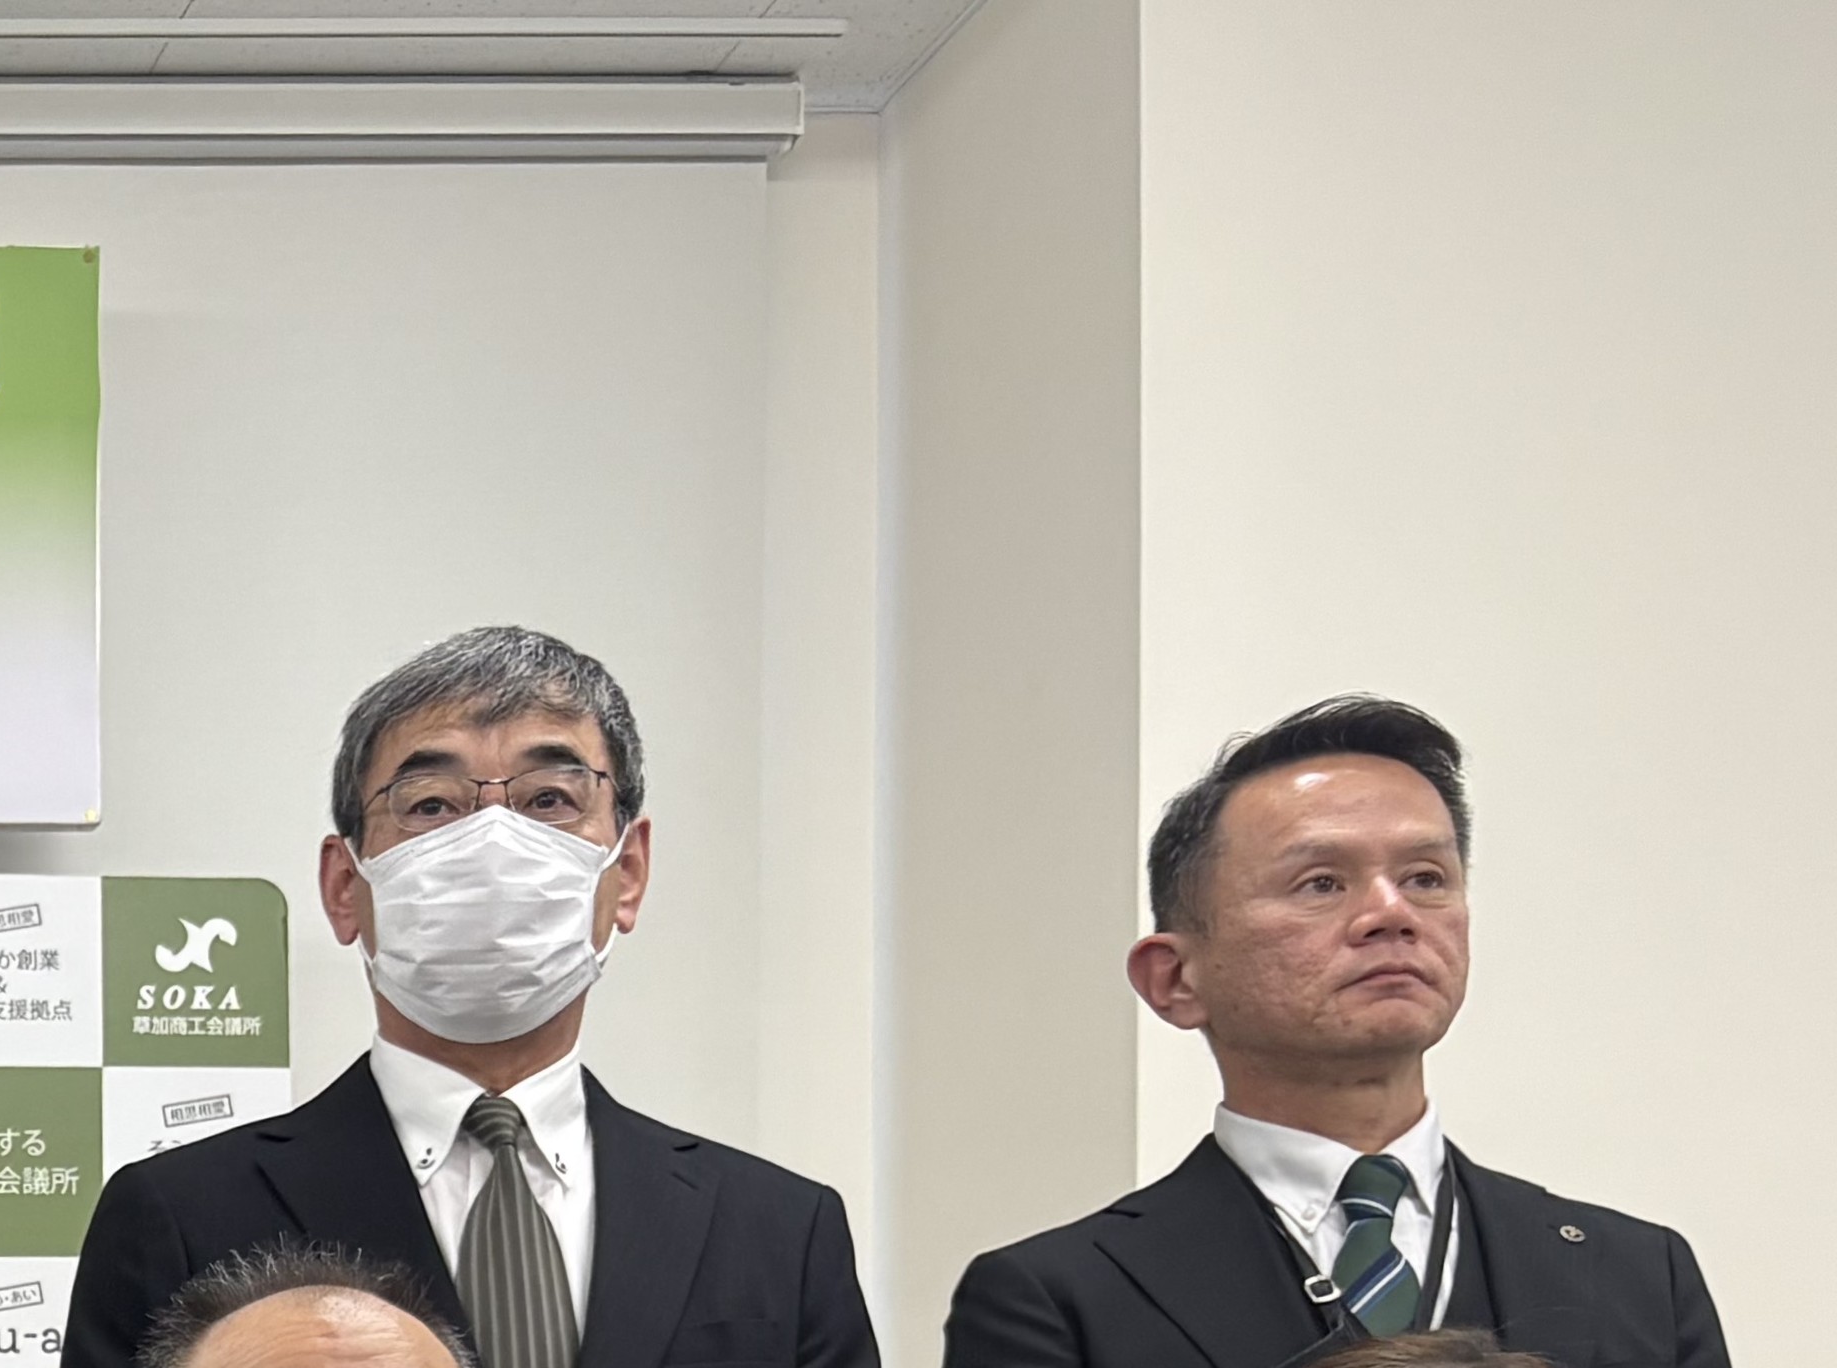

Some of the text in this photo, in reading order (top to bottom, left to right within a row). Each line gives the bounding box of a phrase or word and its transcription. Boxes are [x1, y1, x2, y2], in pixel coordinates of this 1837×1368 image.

[137, 985, 241, 1009] SOKA
[133, 1016, 261, 1035] 草加商工会議所
